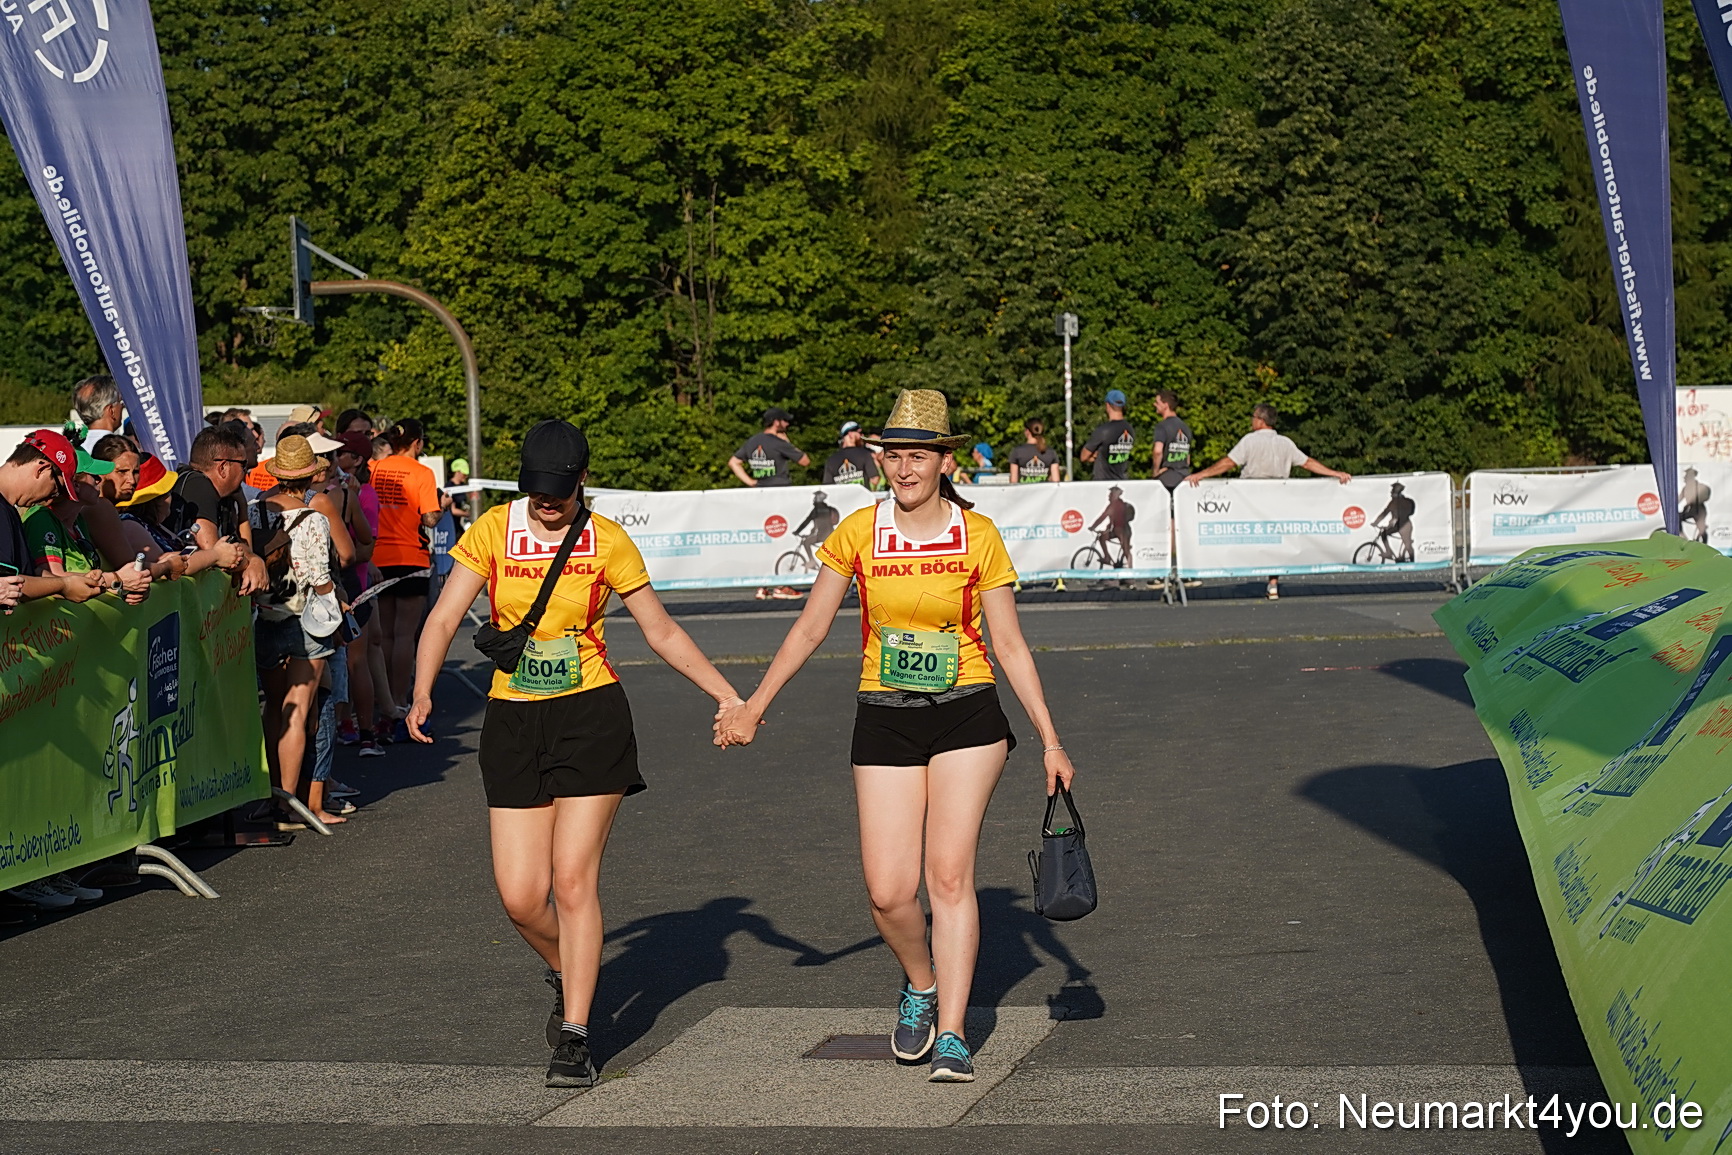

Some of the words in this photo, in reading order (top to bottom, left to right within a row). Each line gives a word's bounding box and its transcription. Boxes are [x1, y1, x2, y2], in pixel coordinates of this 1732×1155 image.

[1197, 501, 1231, 514] NOW
[1493, 493, 1529, 506] NOW
[615, 514, 650, 527] NOW
[1494, 515, 1545, 527] E-BIKES
[1547, 514, 1557, 525] &
[1560, 508, 1641, 524] FAHRRÄDER
[1200, 523, 1251, 535] E-BIKES
[1253, 523, 1264, 534] &
[1267, 521, 1345, 534] FAHRRÄDER
[673, 534, 684, 546] &
[686, 529, 767, 546] FAHRRÄDER
[504, 564, 544, 579] MAX
[562, 561, 596, 576] ÖGL
[871, 563, 915, 578] MAX
[920, 558, 970, 576] BÖGL
[521, 655, 568, 678] 1604
[883, 653, 892, 675] RUN
[897, 650, 938, 673] 820
[569, 659, 578, 685] 2022
[890, 669, 916, 680] Wagner
[917, 673, 945, 682] Carolin
[945, 657, 955, 685] 2022
[522, 675, 542, 685] Bauer
[543, 678, 563, 686] Viola
